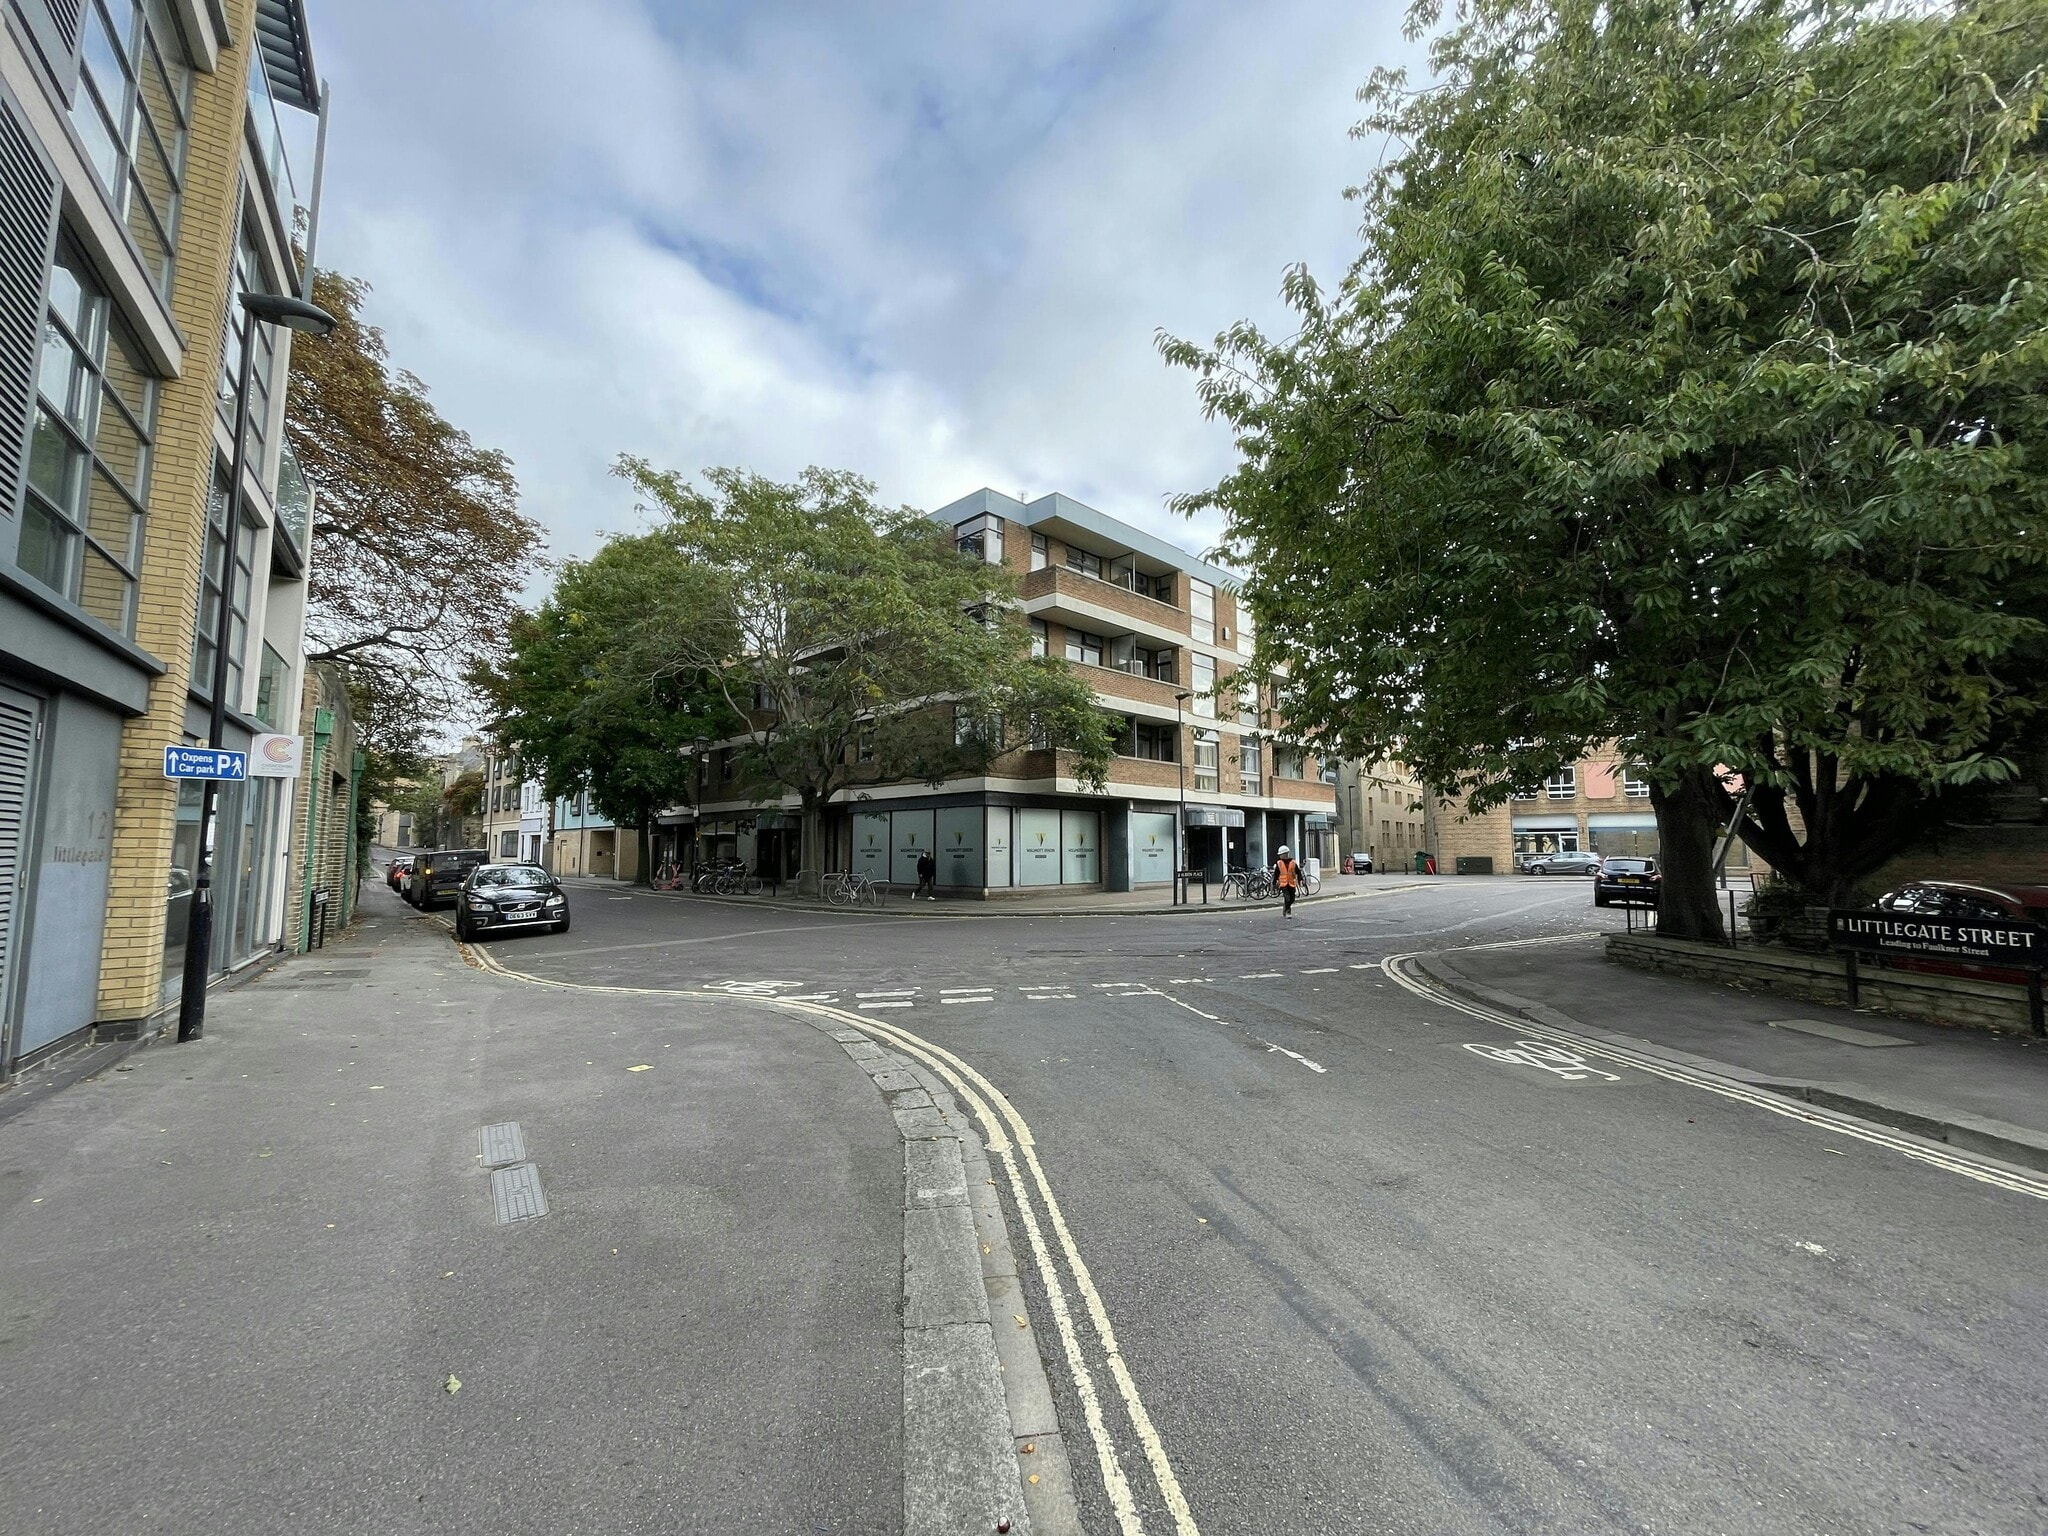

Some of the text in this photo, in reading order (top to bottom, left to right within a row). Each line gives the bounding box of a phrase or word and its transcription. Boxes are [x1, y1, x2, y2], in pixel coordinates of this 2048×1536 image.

[181, 752, 213, 763] Oxpens
[217, 754, 231, 775] P
[179, 764, 215, 775] Car park
[1848, 918, 2035, 948] LITTLEGATE STREET
[1879, 938, 1989, 956] Leading to Faulkner Street
